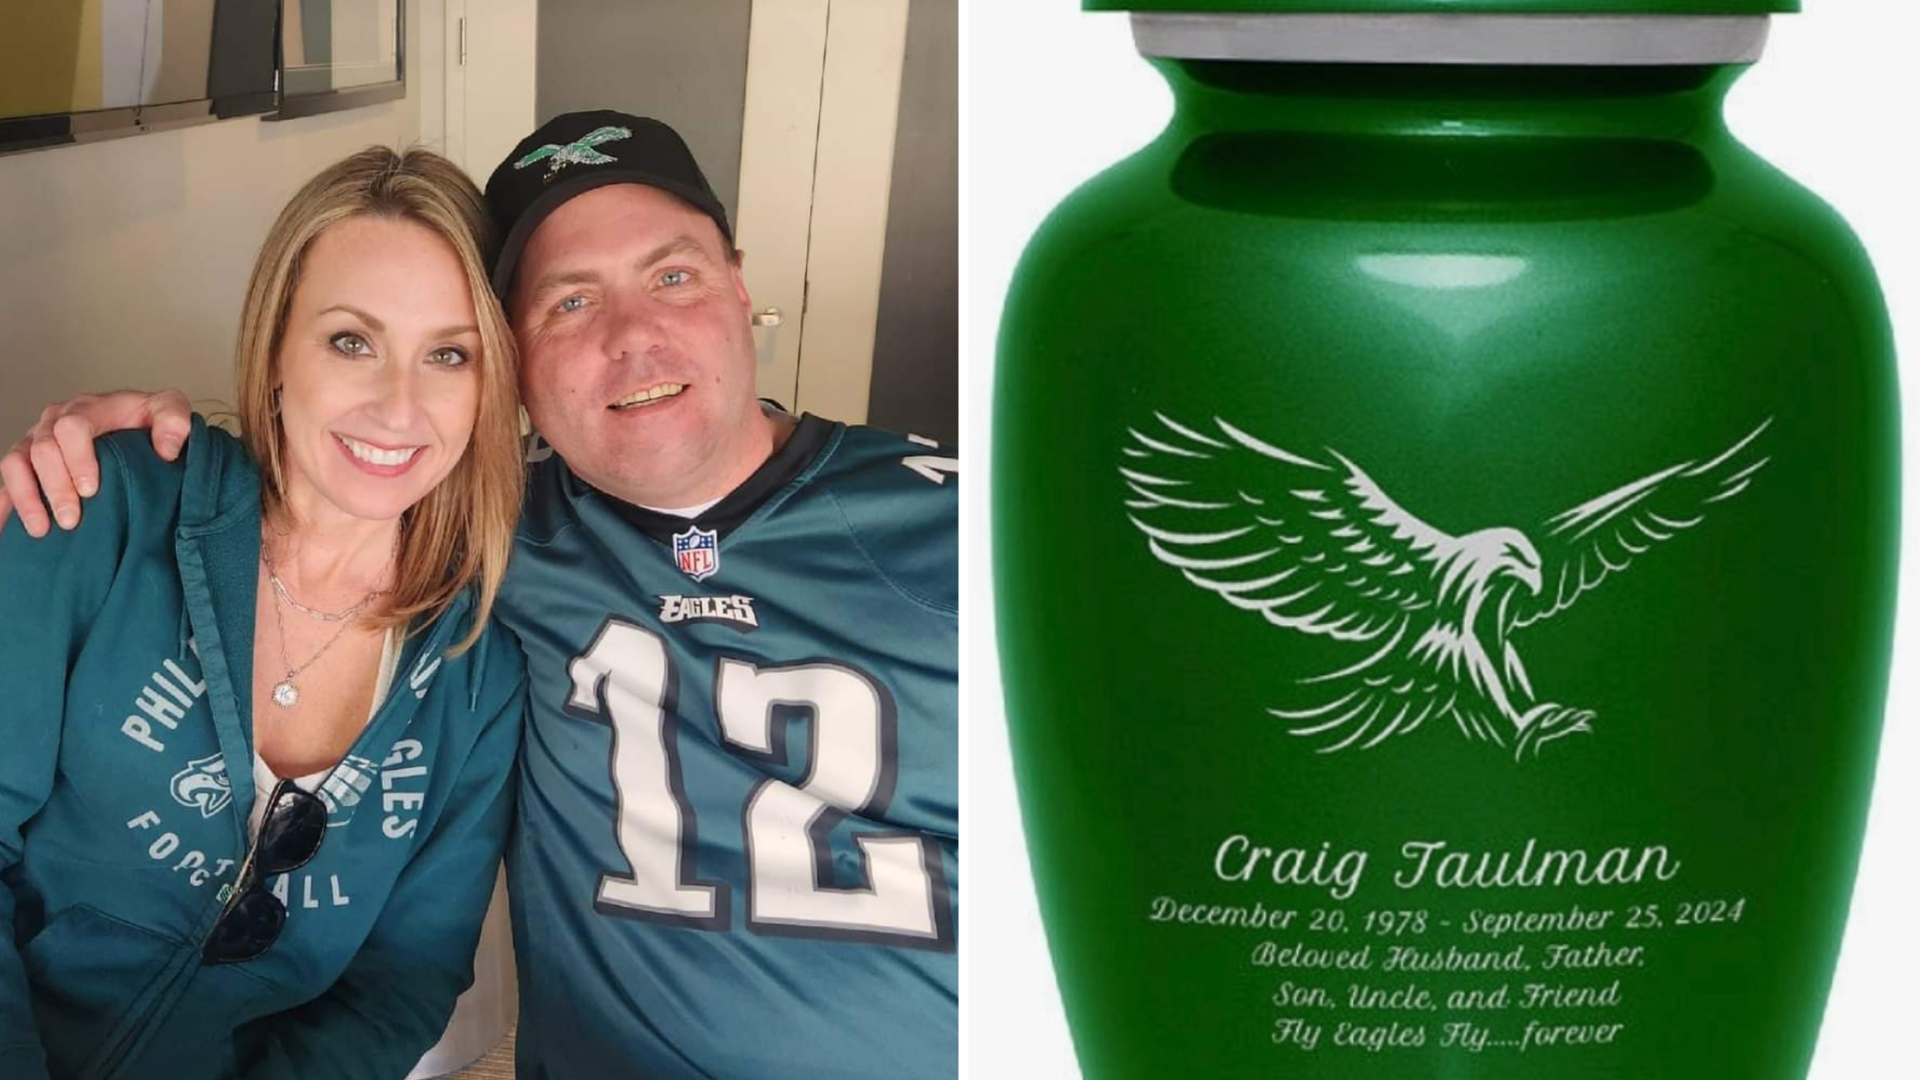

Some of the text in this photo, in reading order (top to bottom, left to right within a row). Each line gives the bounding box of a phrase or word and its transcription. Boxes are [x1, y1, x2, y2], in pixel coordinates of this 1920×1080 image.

[679, 549, 713, 573] NFL
[658, 594, 760, 627] EAGLES
[380, 738, 428, 840] GLES
[563, 613, 958, 956] 12
[1213, 834, 1681, 900] Craig Taulman
[1149, 896, 1296, 930] December
[1364, 910, 1429, 936] 1978
[1462, 905, 1614, 938] September
[1675, 897, 1747, 926] 2024
[1251, 941, 1372, 970] Beloved
[1447, 984, 1512, 1010] and
[1518, 980, 1622, 1009] Friend
[1271, 1018, 1322, 1051] Fly
[1333, 1021, 1427, 1052] Eagles
